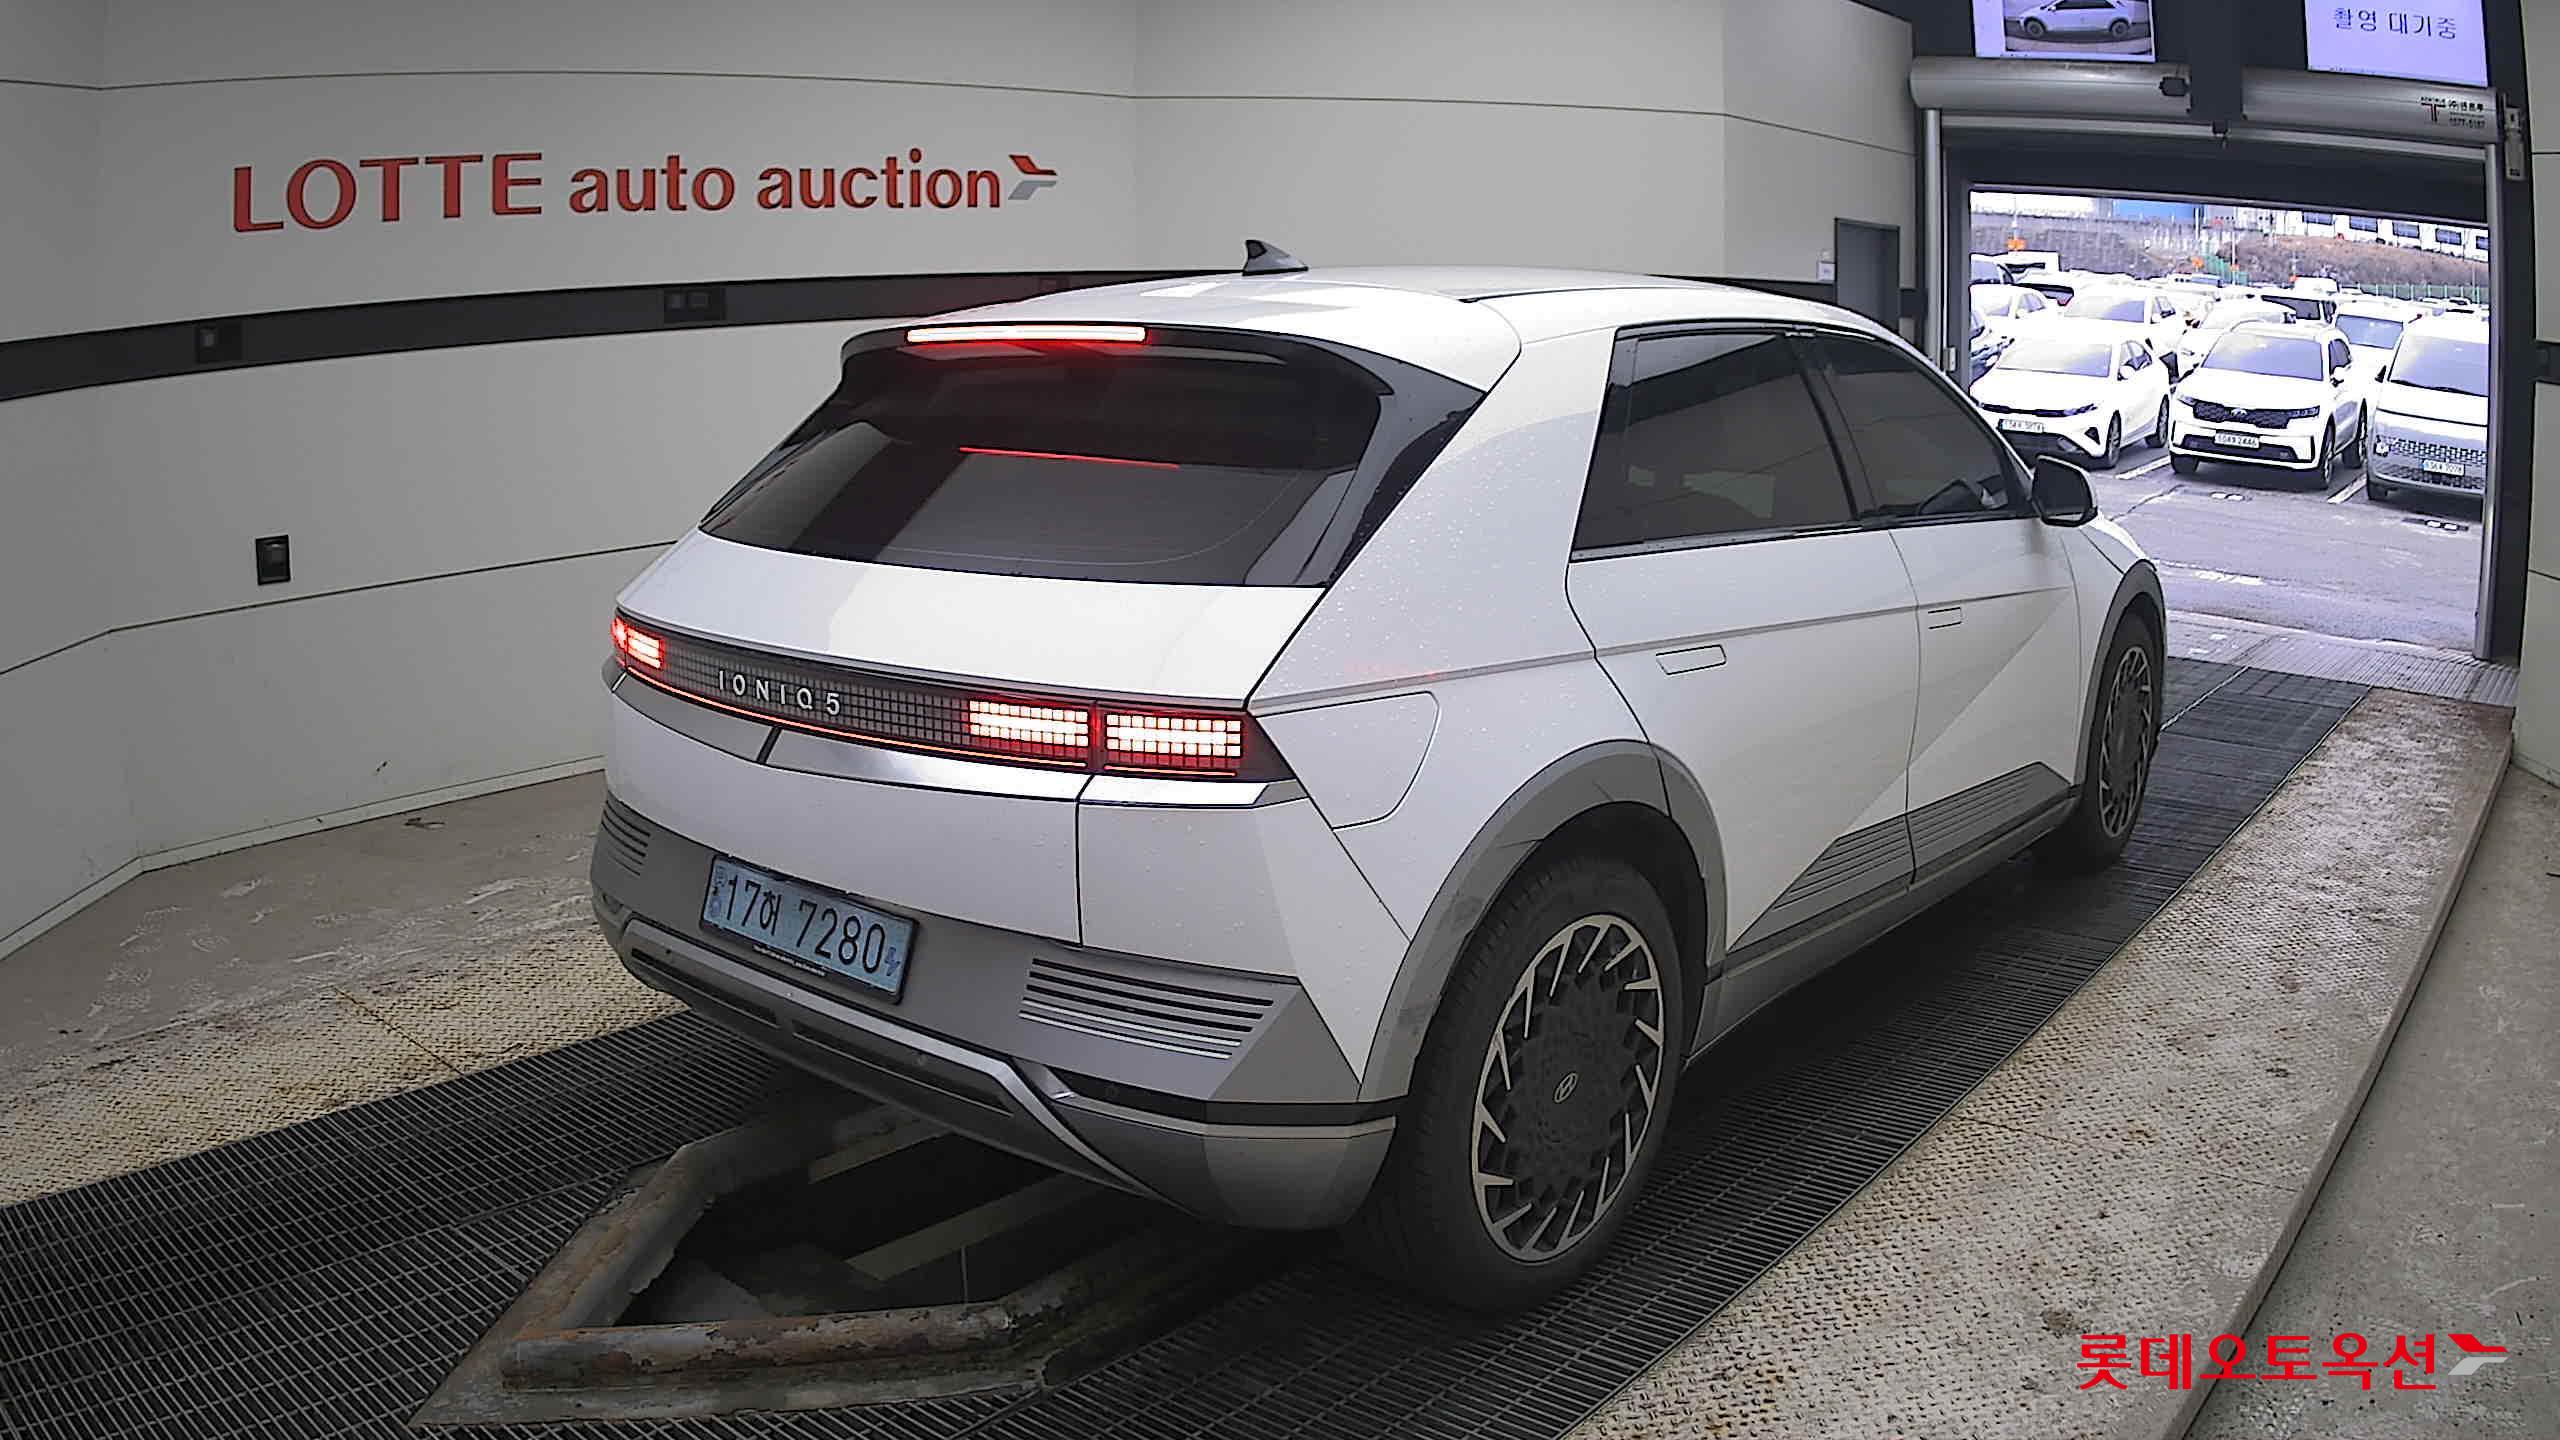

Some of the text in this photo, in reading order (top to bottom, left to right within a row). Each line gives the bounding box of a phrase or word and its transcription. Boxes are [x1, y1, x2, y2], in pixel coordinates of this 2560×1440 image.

[2388, 12, 2457, 40] 대기중
[233, 147, 1002, 233] LOTTE auto auction
[718, 669, 841, 716] IONIQ 5
[726, 874, 783, 937] 17허
[797, 900, 887, 974] 7280
